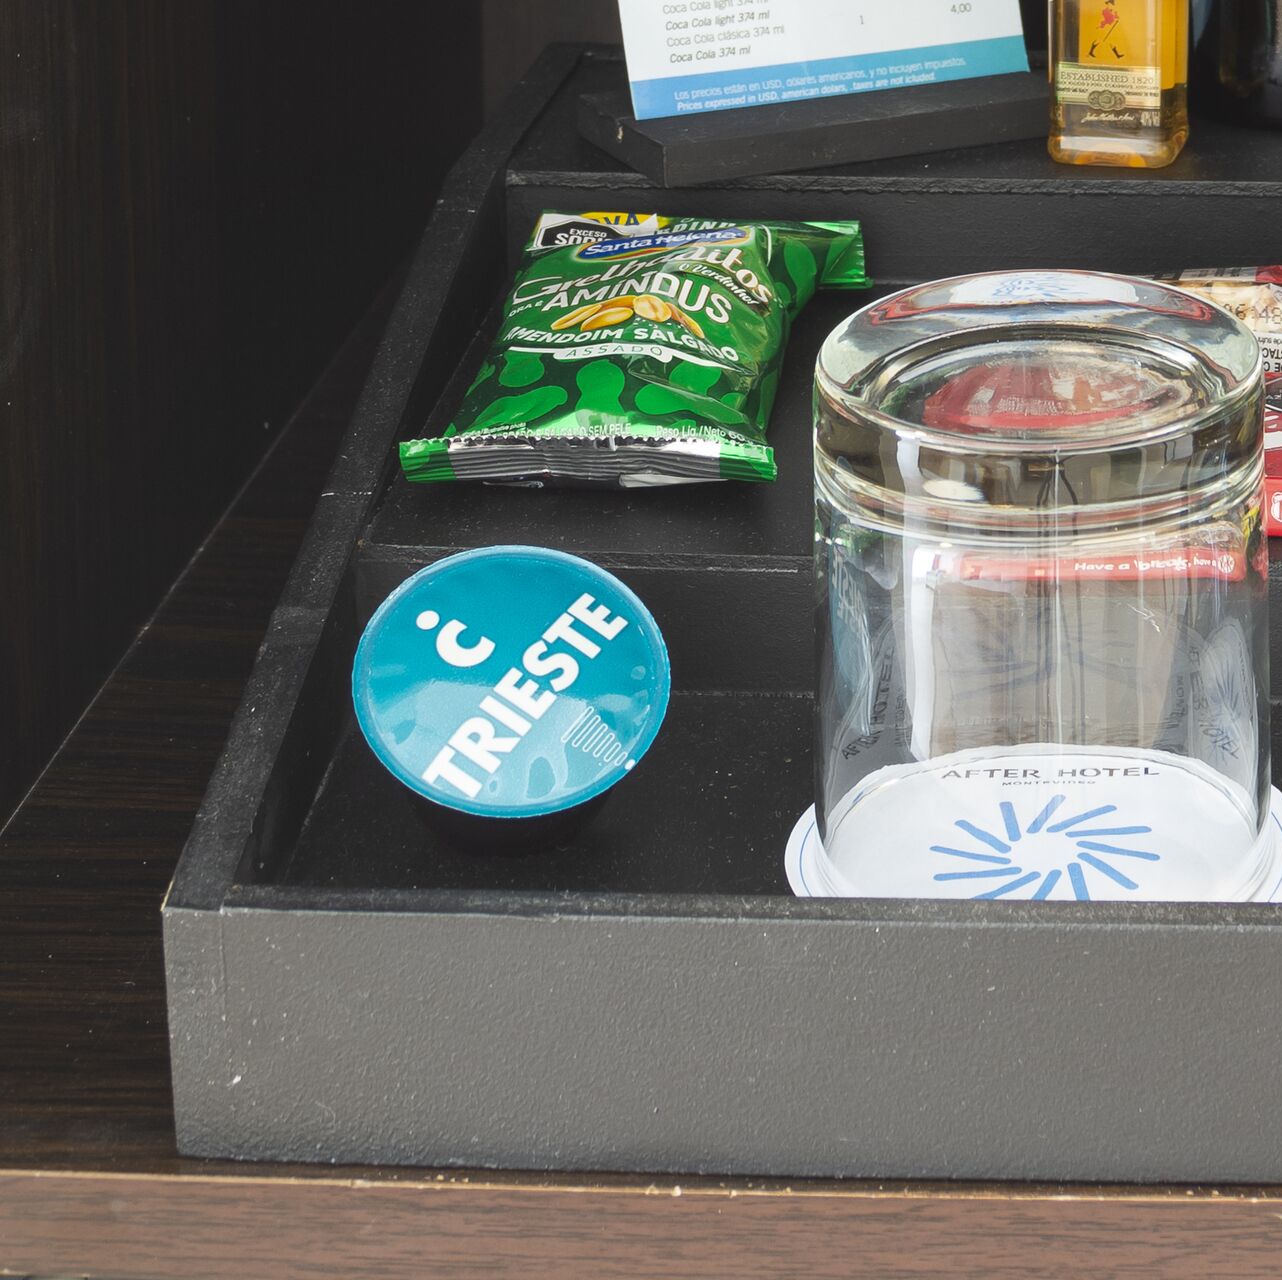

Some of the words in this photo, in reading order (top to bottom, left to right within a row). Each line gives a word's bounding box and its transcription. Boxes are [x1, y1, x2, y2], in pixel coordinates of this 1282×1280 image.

[665, 20, 689, 31] Coca
[691, 17, 712, 28] Cola
[715, 14, 735, 27] light
[738, 11, 755, 23] 374
[758, 10, 770, 20] ml
[669, 53, 693, 64] Coca
[695, 49, 716, 61] Cola
[718, 46, 736, 58] 374
[739, 45, 751, 55] ml
[1060, 71, 1129, 83] ESTABLISHED
[569, 228, 607, 239] EXCESO
[585, 238, 653, 255] Santa
[655, 230, 736, 245] Helena
[503, 326, 624, 345] AMENDOIM
[634, 328, 740, 362] SALGADO
[565, 347, 663, 358] ASSADO
[1074, 562, 1114, 572] Have
[421, 592, 629, 799] TRIESTE
[941, 768, 1041, 780] AFTER
[1058, 766, 1160, 778] HOTEL
